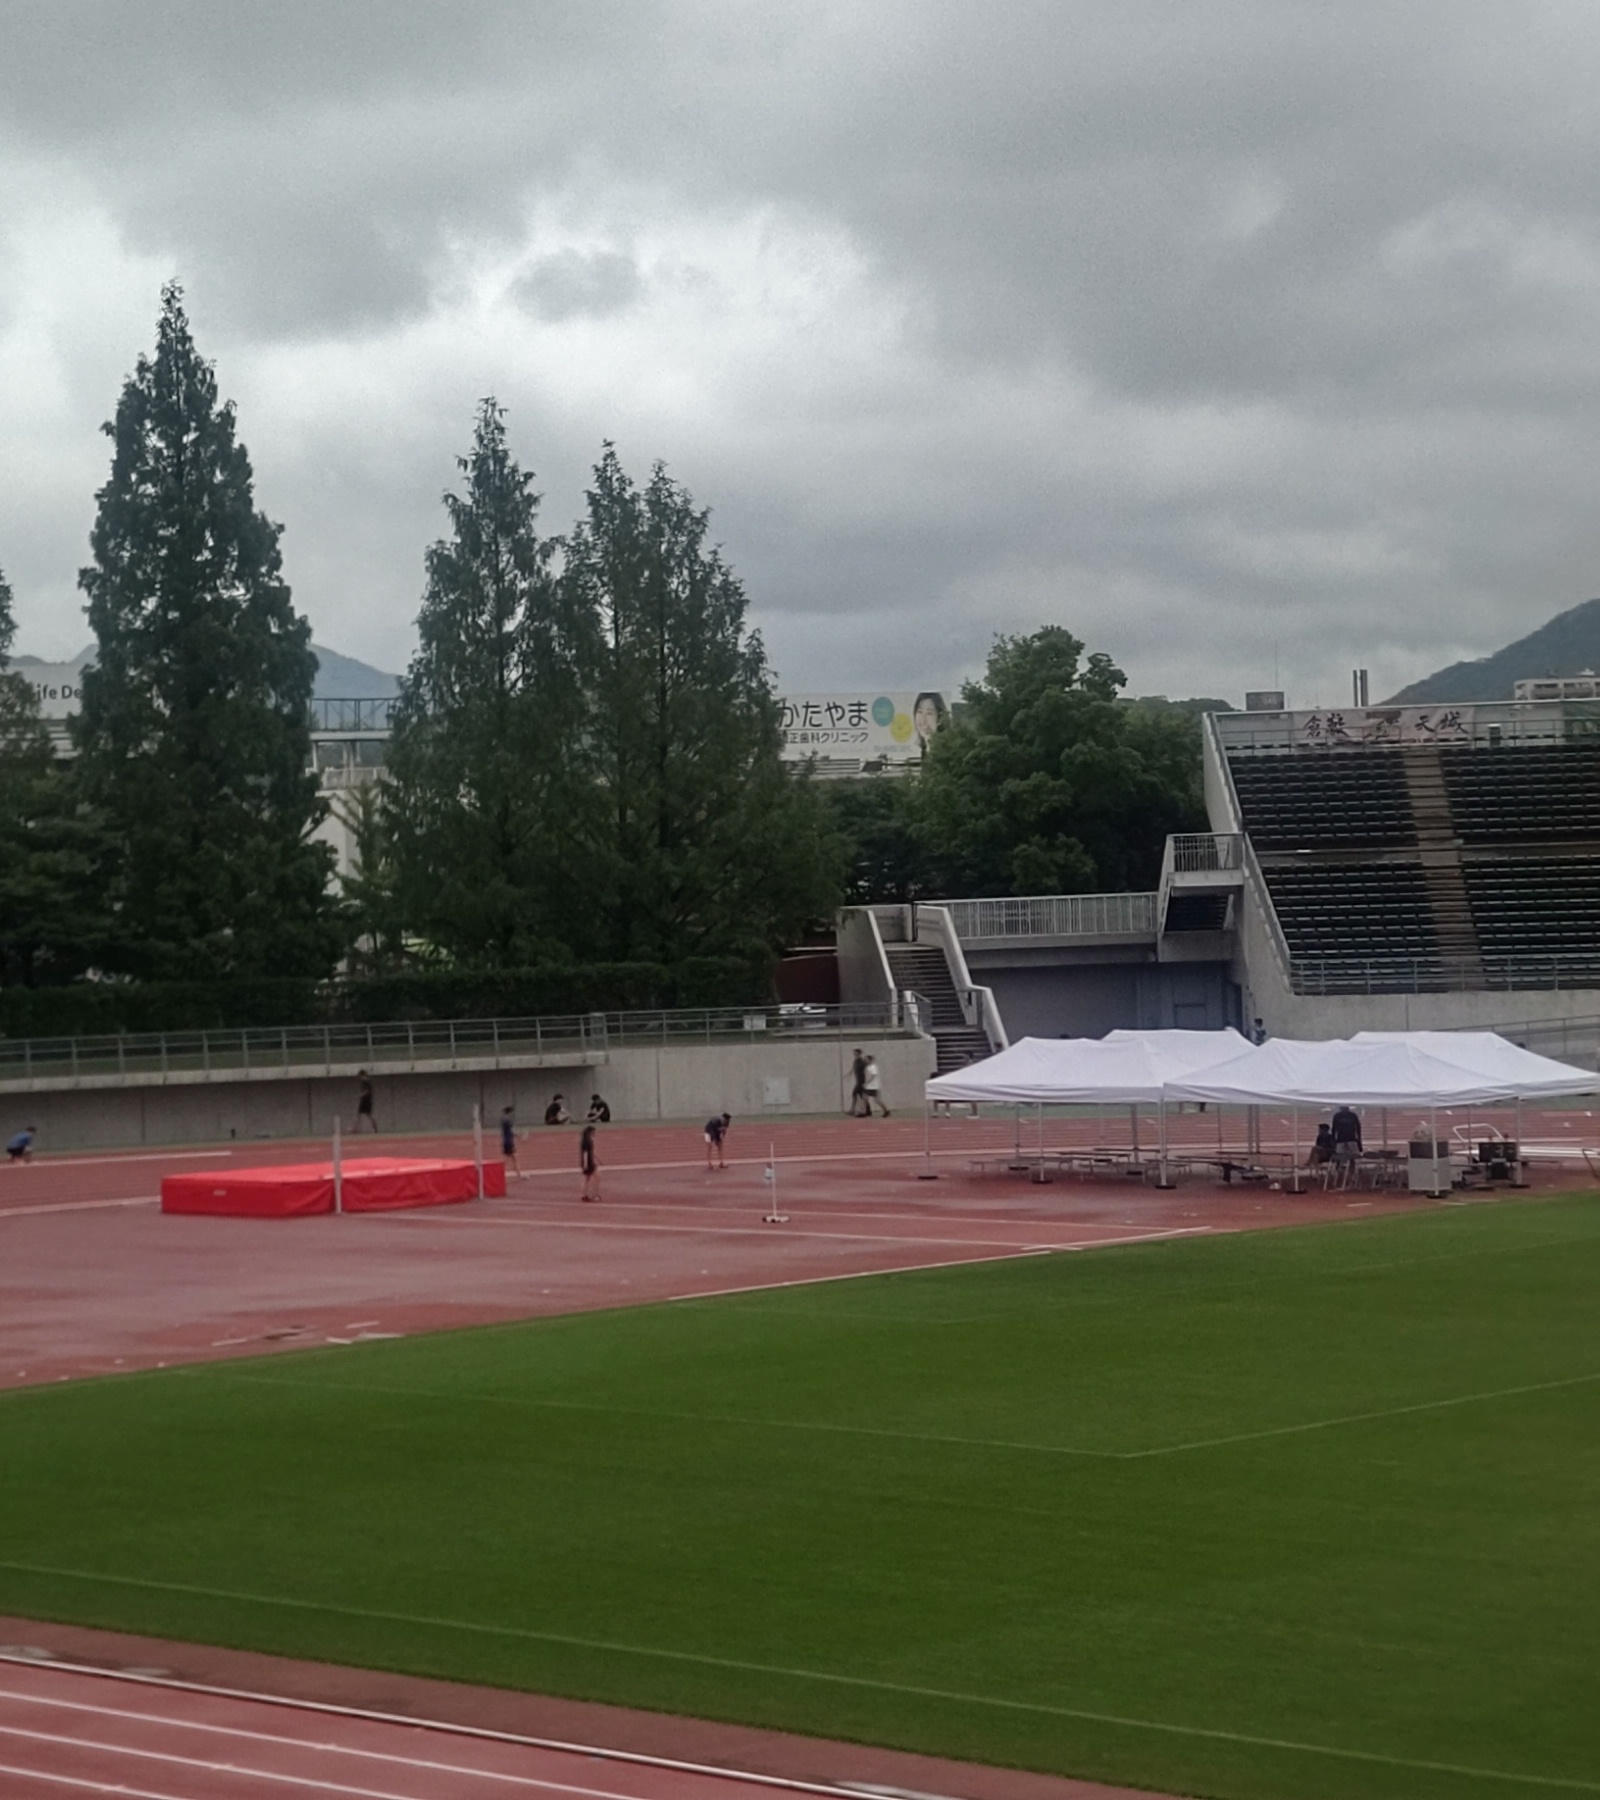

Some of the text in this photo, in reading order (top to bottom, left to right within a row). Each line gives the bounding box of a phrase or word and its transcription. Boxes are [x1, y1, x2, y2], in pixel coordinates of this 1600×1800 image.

[777, 698, 869, 728] かたやま
[780, 731, 869, 744] 正歯科クリニック
